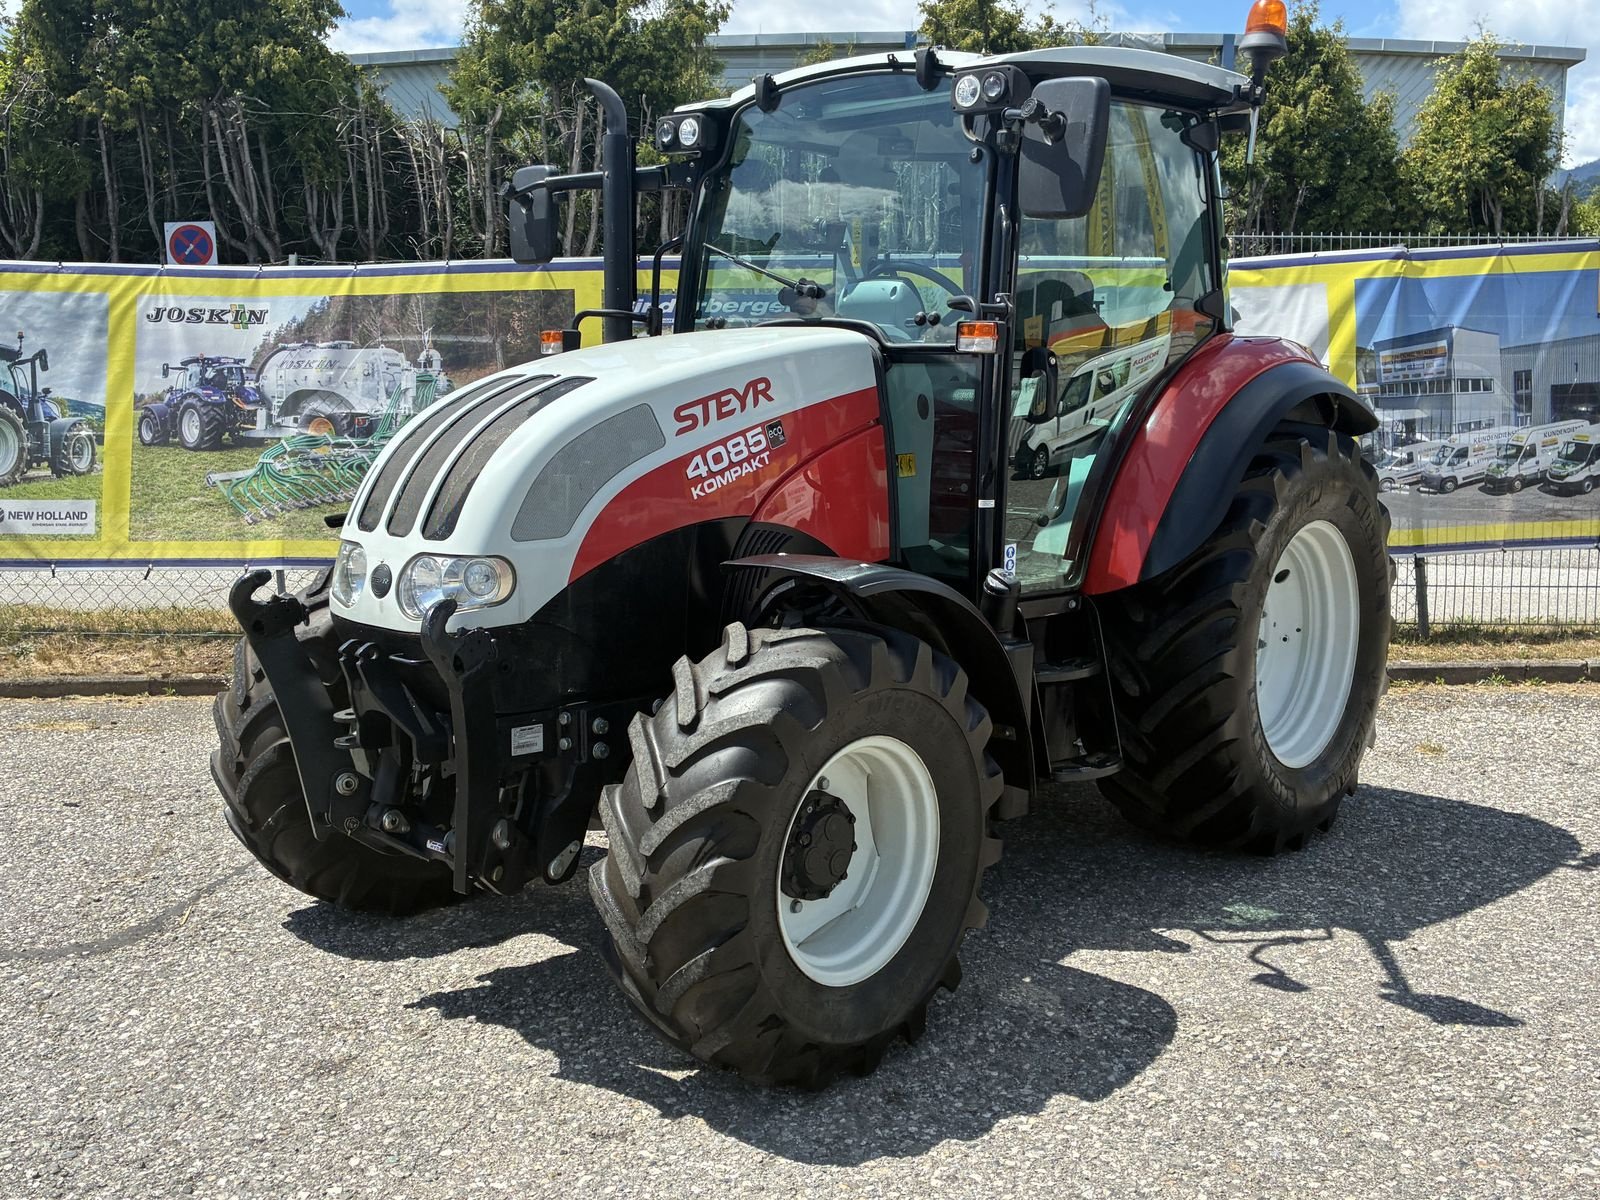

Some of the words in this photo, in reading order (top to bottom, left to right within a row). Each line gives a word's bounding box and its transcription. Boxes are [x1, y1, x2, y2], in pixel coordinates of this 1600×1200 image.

[146, 305, 269, 325] JOSKIN
[673, 377, 775, 437] STEYR
[686, 427, 767, 479] 4085
[768, 426, 783, 439] eco
[690, 452, 769, 500] KOMPAKT
[8, 511, 34, 521] NEW
[36, 511, 88, 521] HOLLAND
